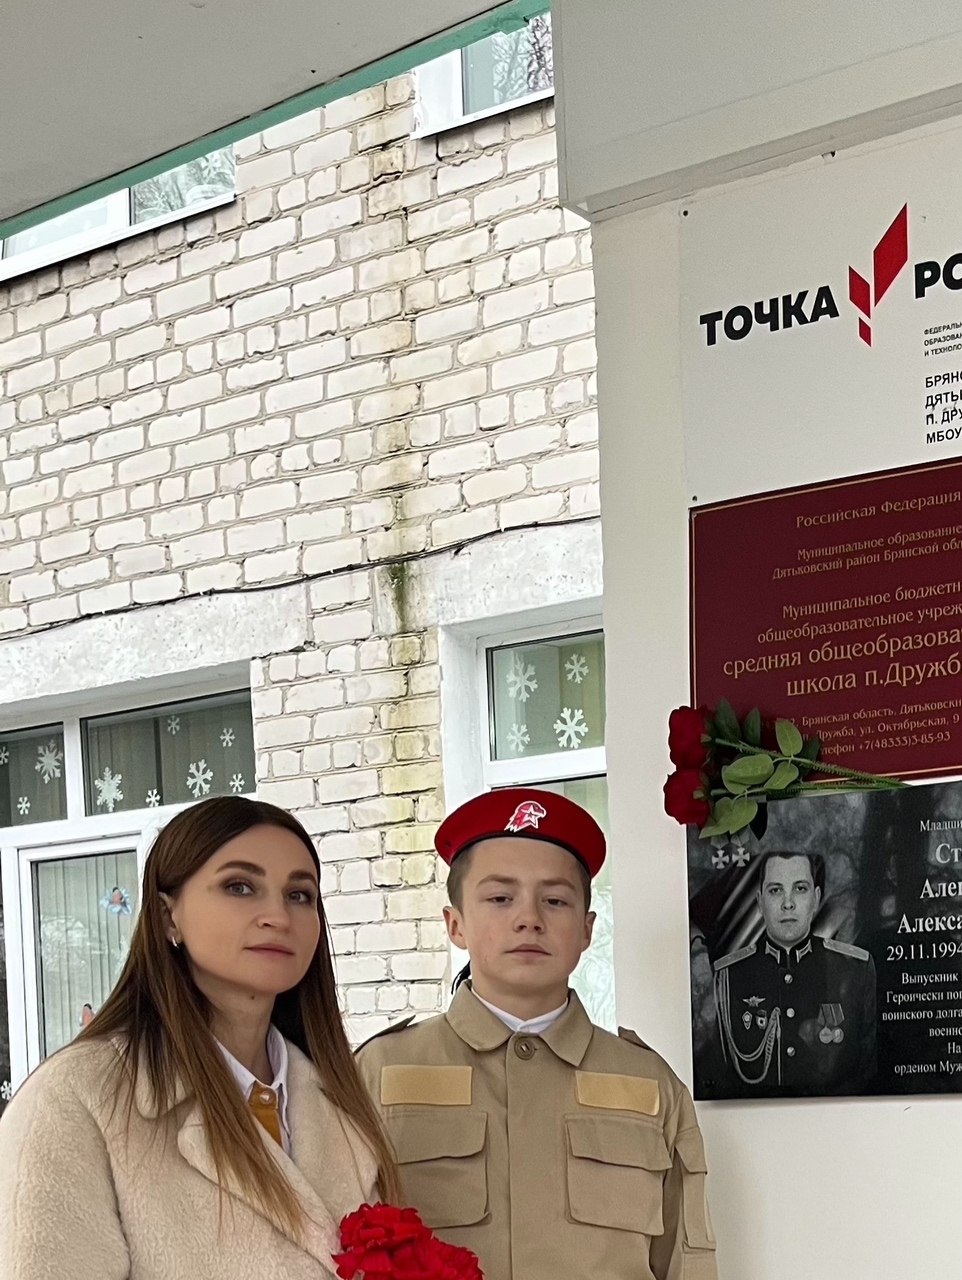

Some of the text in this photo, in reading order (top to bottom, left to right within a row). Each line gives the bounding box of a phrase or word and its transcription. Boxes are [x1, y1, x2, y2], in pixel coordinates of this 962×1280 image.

[700, 286, 839, 346] ТОЧКА
[926, 414, 938, 425] П.
[926, 427, 962, 444] МБОУ
[796, 491, 961, 528] Российская Федерация
[798, 524, 962, 561] Муниципальное образование
[772, 557, 843, 580] Дятьковский
[846, 554, 880, 569] район
[884, 543, 939, 562] Брянской
[783, 592, 890, 620] Муниципальное
[758, 610, 914, 644] общеобразовательное
[723, 651, 801, 679] средняя
[787, 672, 857, 696] школа
[802, 713, 849, 728] Брянская
[860, 726, 874, 736] ул.
[953, 714, 960, 723] 9
[823, 744, 855, 755] лефон
[902, 972, 958, 986] Выпускник
[886, 990, 944, 1005] Героически
[882, 1010, 933, 1021] воинского
[894, 1065, 936, 1076] орденом
